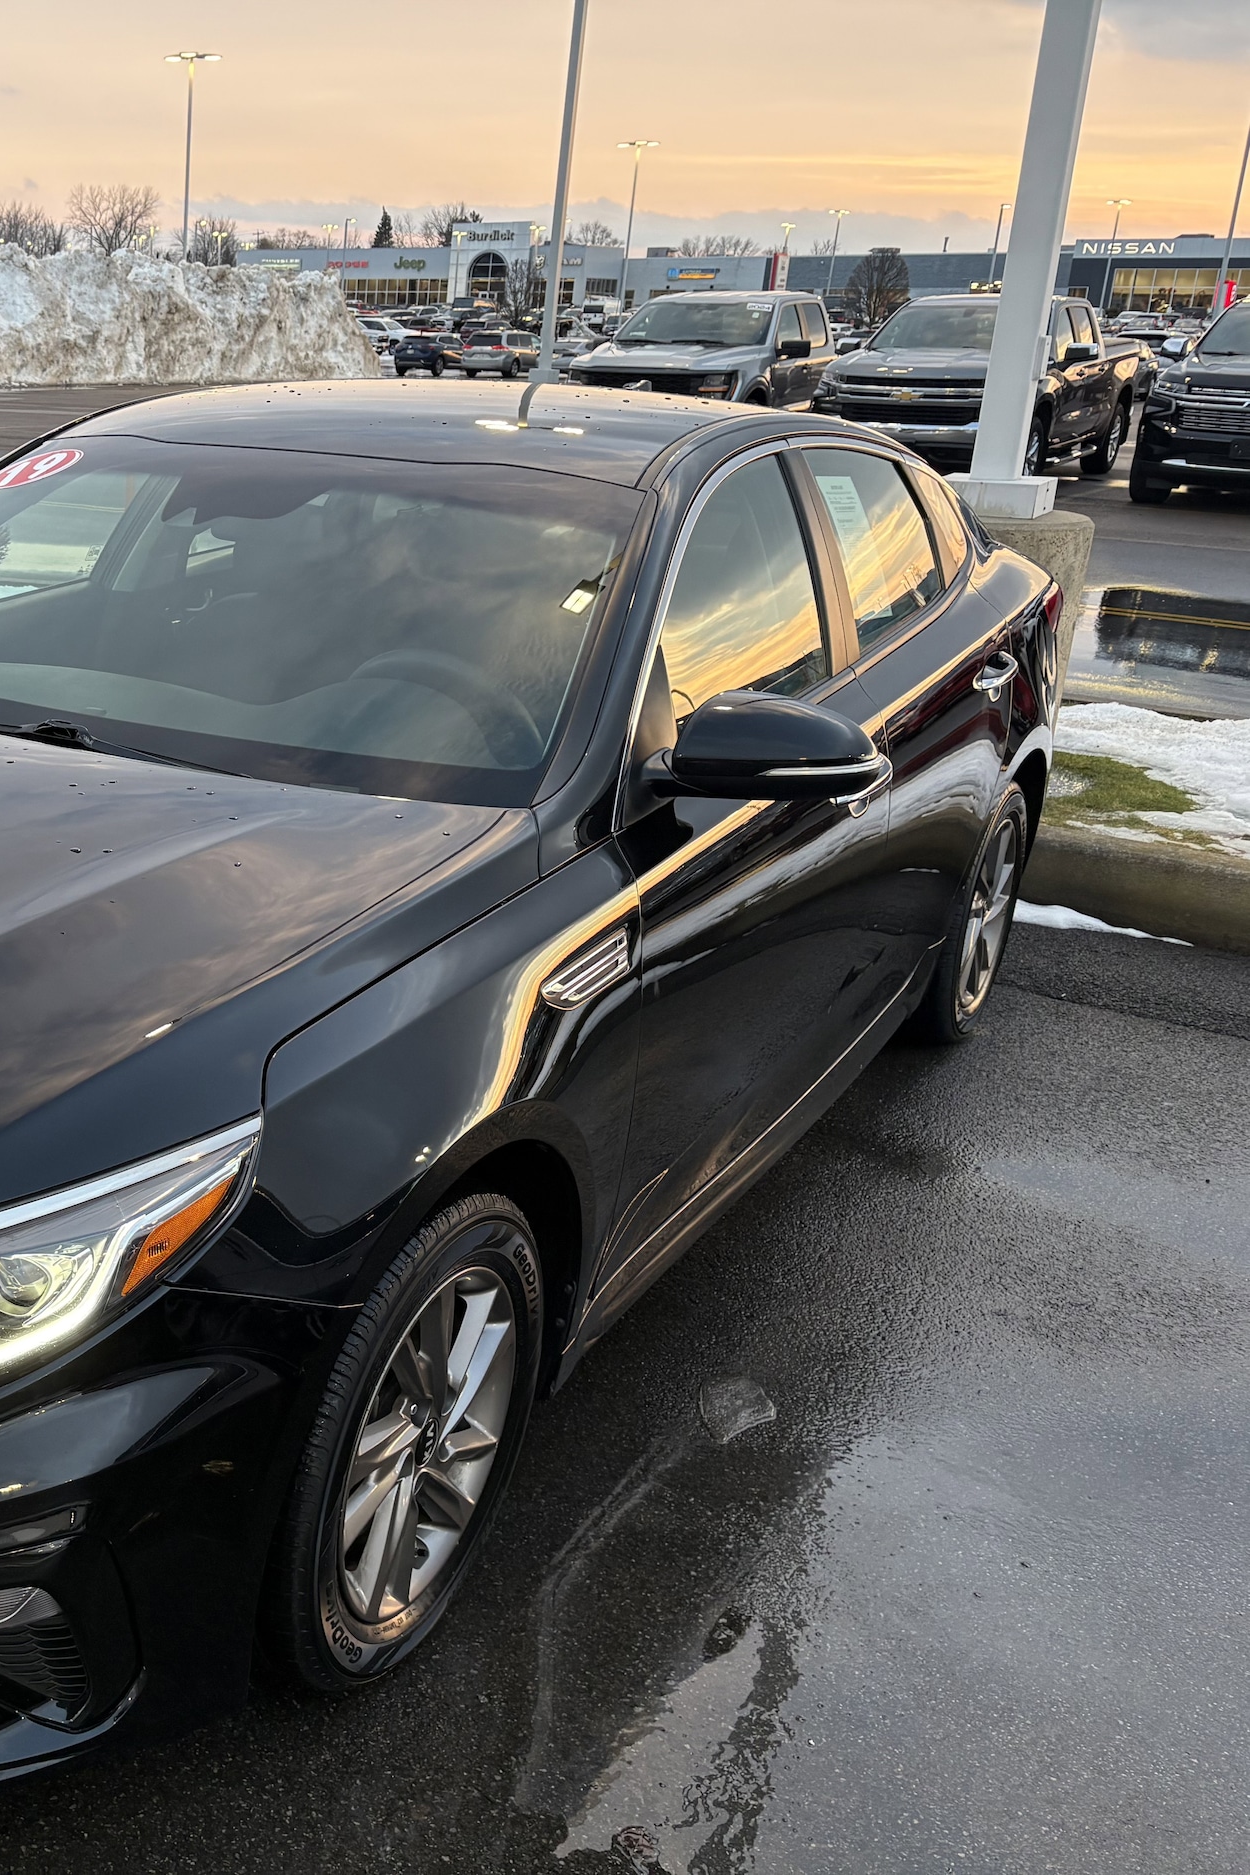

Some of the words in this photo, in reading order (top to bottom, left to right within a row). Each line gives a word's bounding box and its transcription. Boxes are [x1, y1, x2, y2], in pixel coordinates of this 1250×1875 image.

[467, 230, 515, 241] Burdick
[1082, 242, 1175, 254] NISSAN
[394, 256, 426, 271] Jeep
[422, 1422, 435, 1462] KIA
